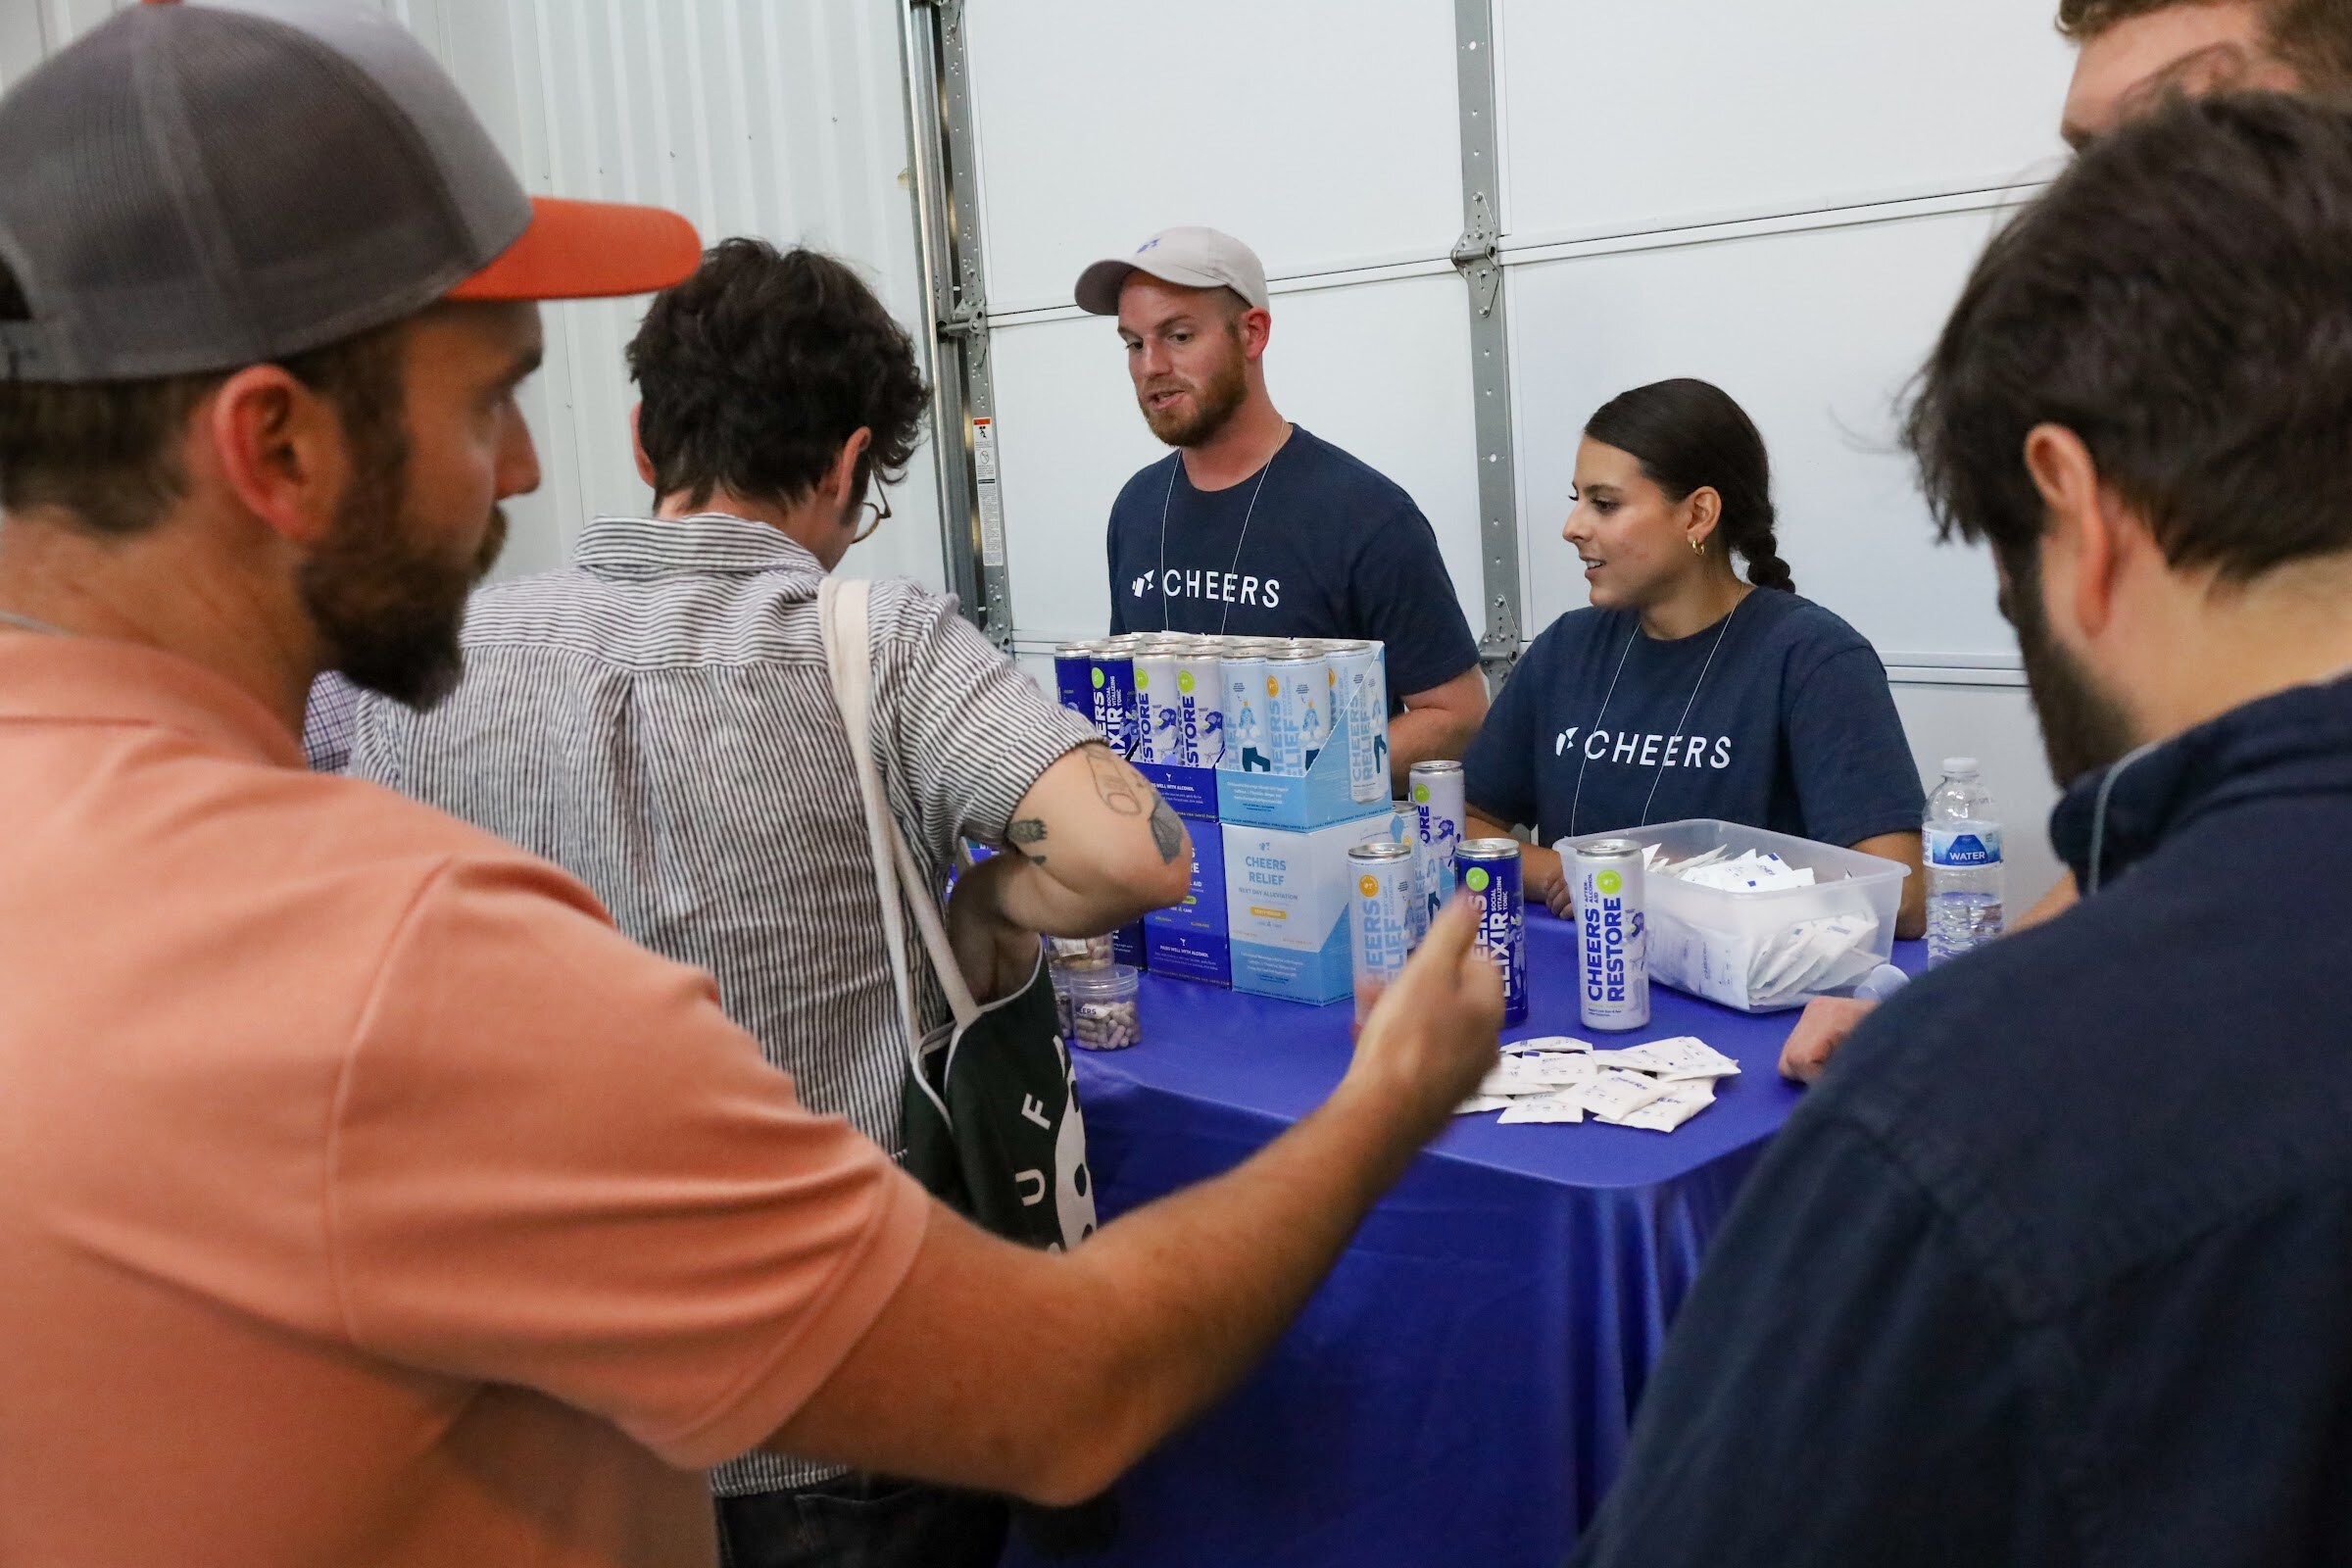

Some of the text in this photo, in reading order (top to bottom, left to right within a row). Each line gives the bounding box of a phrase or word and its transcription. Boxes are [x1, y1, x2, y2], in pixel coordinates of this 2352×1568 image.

[1163, 568, 1280, 609] CHEERS
[1139, 693, 1153, 763] STORE
[1183, 696, 1200, 768] STORE
[1585, 730, 1732, 769] CHEERS
[1245, 856, 1287, 871] CHEERS
[1949, 851, 1985, 860] WATER
[1249, 871, 1285, 886] RELIEF
[1585, 907, 1603, 1002] CHEERS
[1603, 897, 1625, 1003] RESTORE
